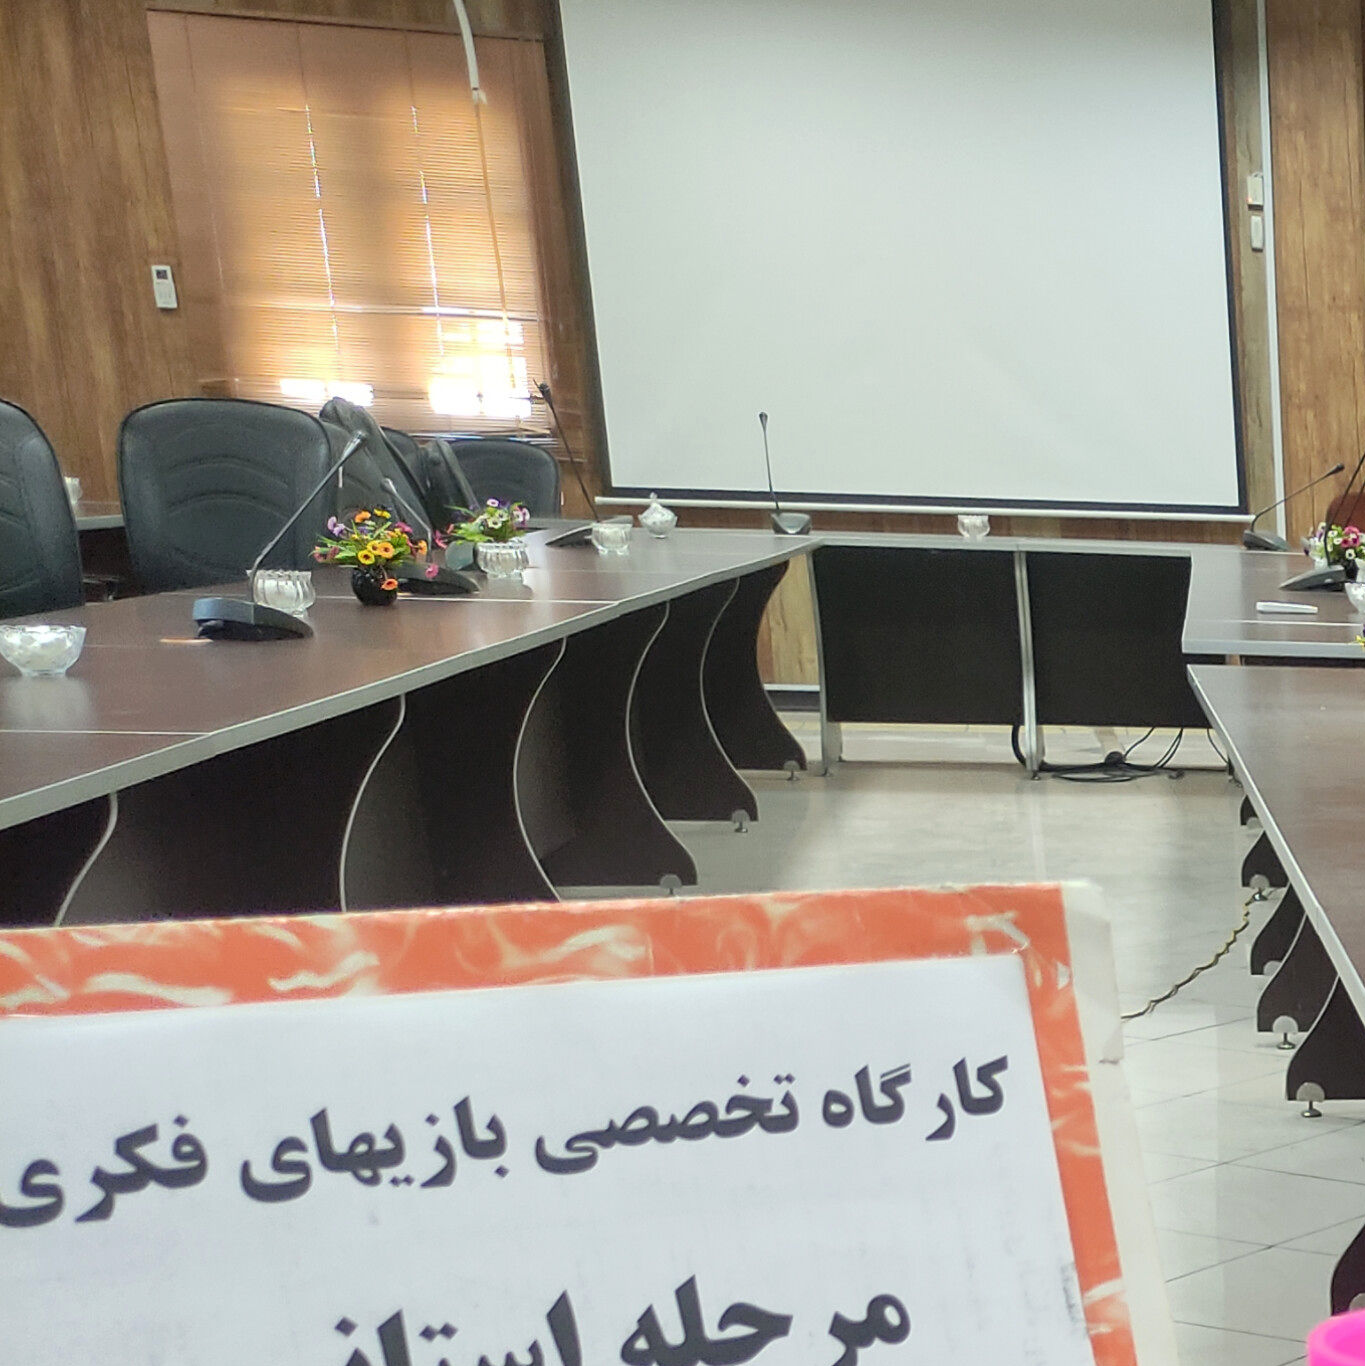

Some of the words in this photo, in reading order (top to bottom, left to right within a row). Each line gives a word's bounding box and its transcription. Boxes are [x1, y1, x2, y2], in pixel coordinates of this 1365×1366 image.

[240, 1096, 508, 1203] بازیهای
[534, 1074, 800, 1175] تخصصی
[822, 1055, 1008, 1141] کارگاه
[0, 1115, 208, 1229] فکری
